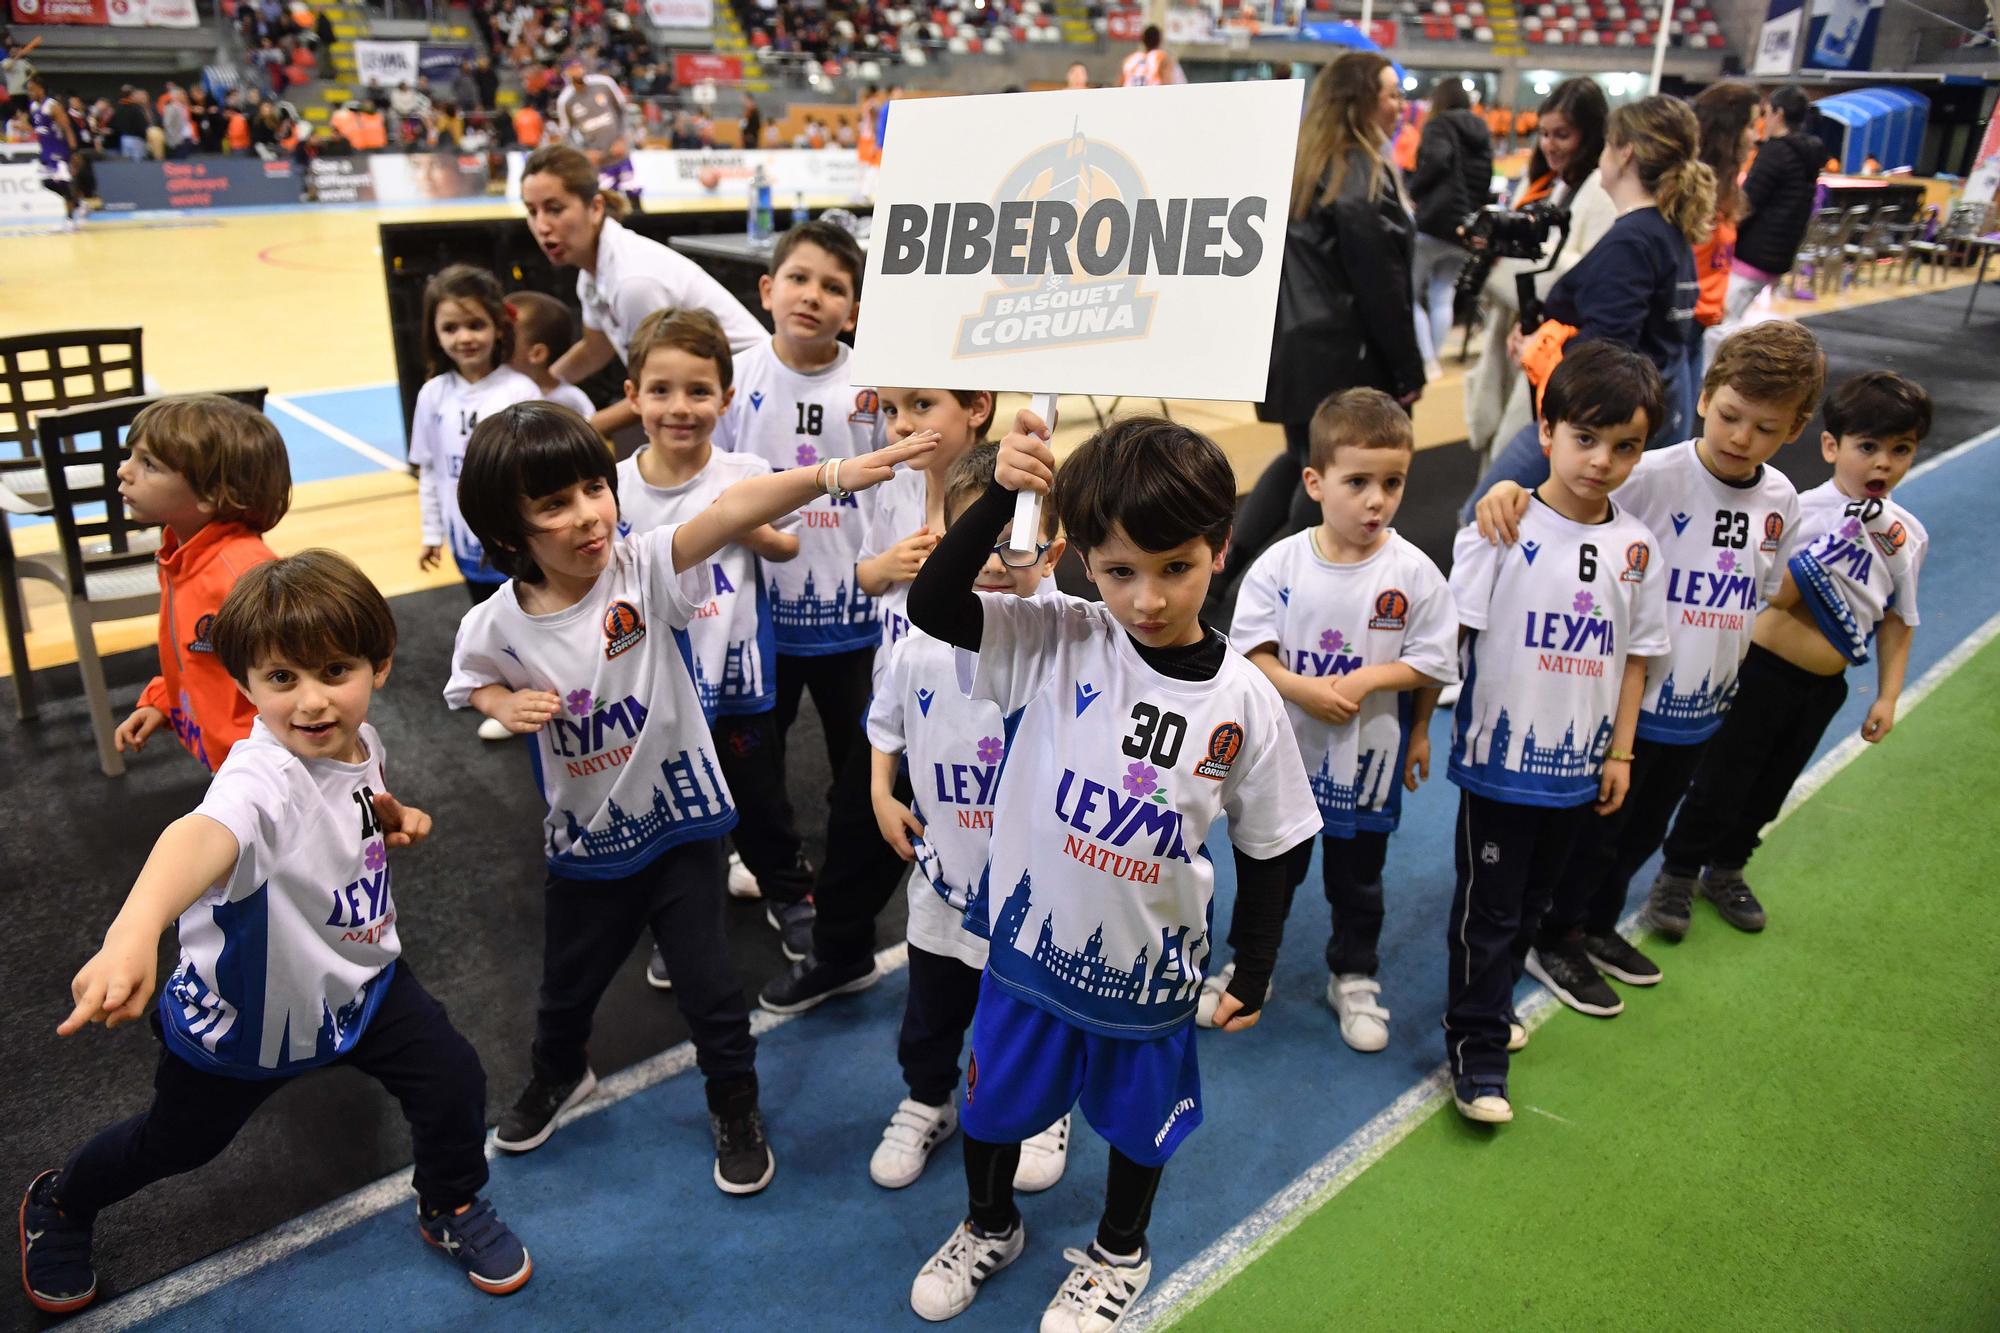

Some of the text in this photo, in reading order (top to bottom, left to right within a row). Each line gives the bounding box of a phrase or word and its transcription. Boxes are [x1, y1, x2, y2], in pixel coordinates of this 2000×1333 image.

[880, 195, 1268, 278] BIBERONES
[995, 283, 1126, 317] BASQUET
[795, 402, 824, 436] 18
[1711, 509, 1750, 550] 23
[1578, 543, 1598, 583] 6
[1666, 567, 1757, 611] LEYMA
[1524, 610, 1614, 657] LEYMA
[1680, 608, 1744, 631] NATURA
[1538, 654, 1604, 677] NATURA
[1121, 701, 1188, 770] 30
[565, 740, 638, 779] NATUR
[934, 762, 999, 806] LEY
[957, 810, 993, 829] NAT
[1055, 767, 1193, 864] LEYMA
[1063, 833, 1161, 885] NATURA
[326, 867, 389, 929] LEY
[1154, 1096, 1196, 1149] macron
